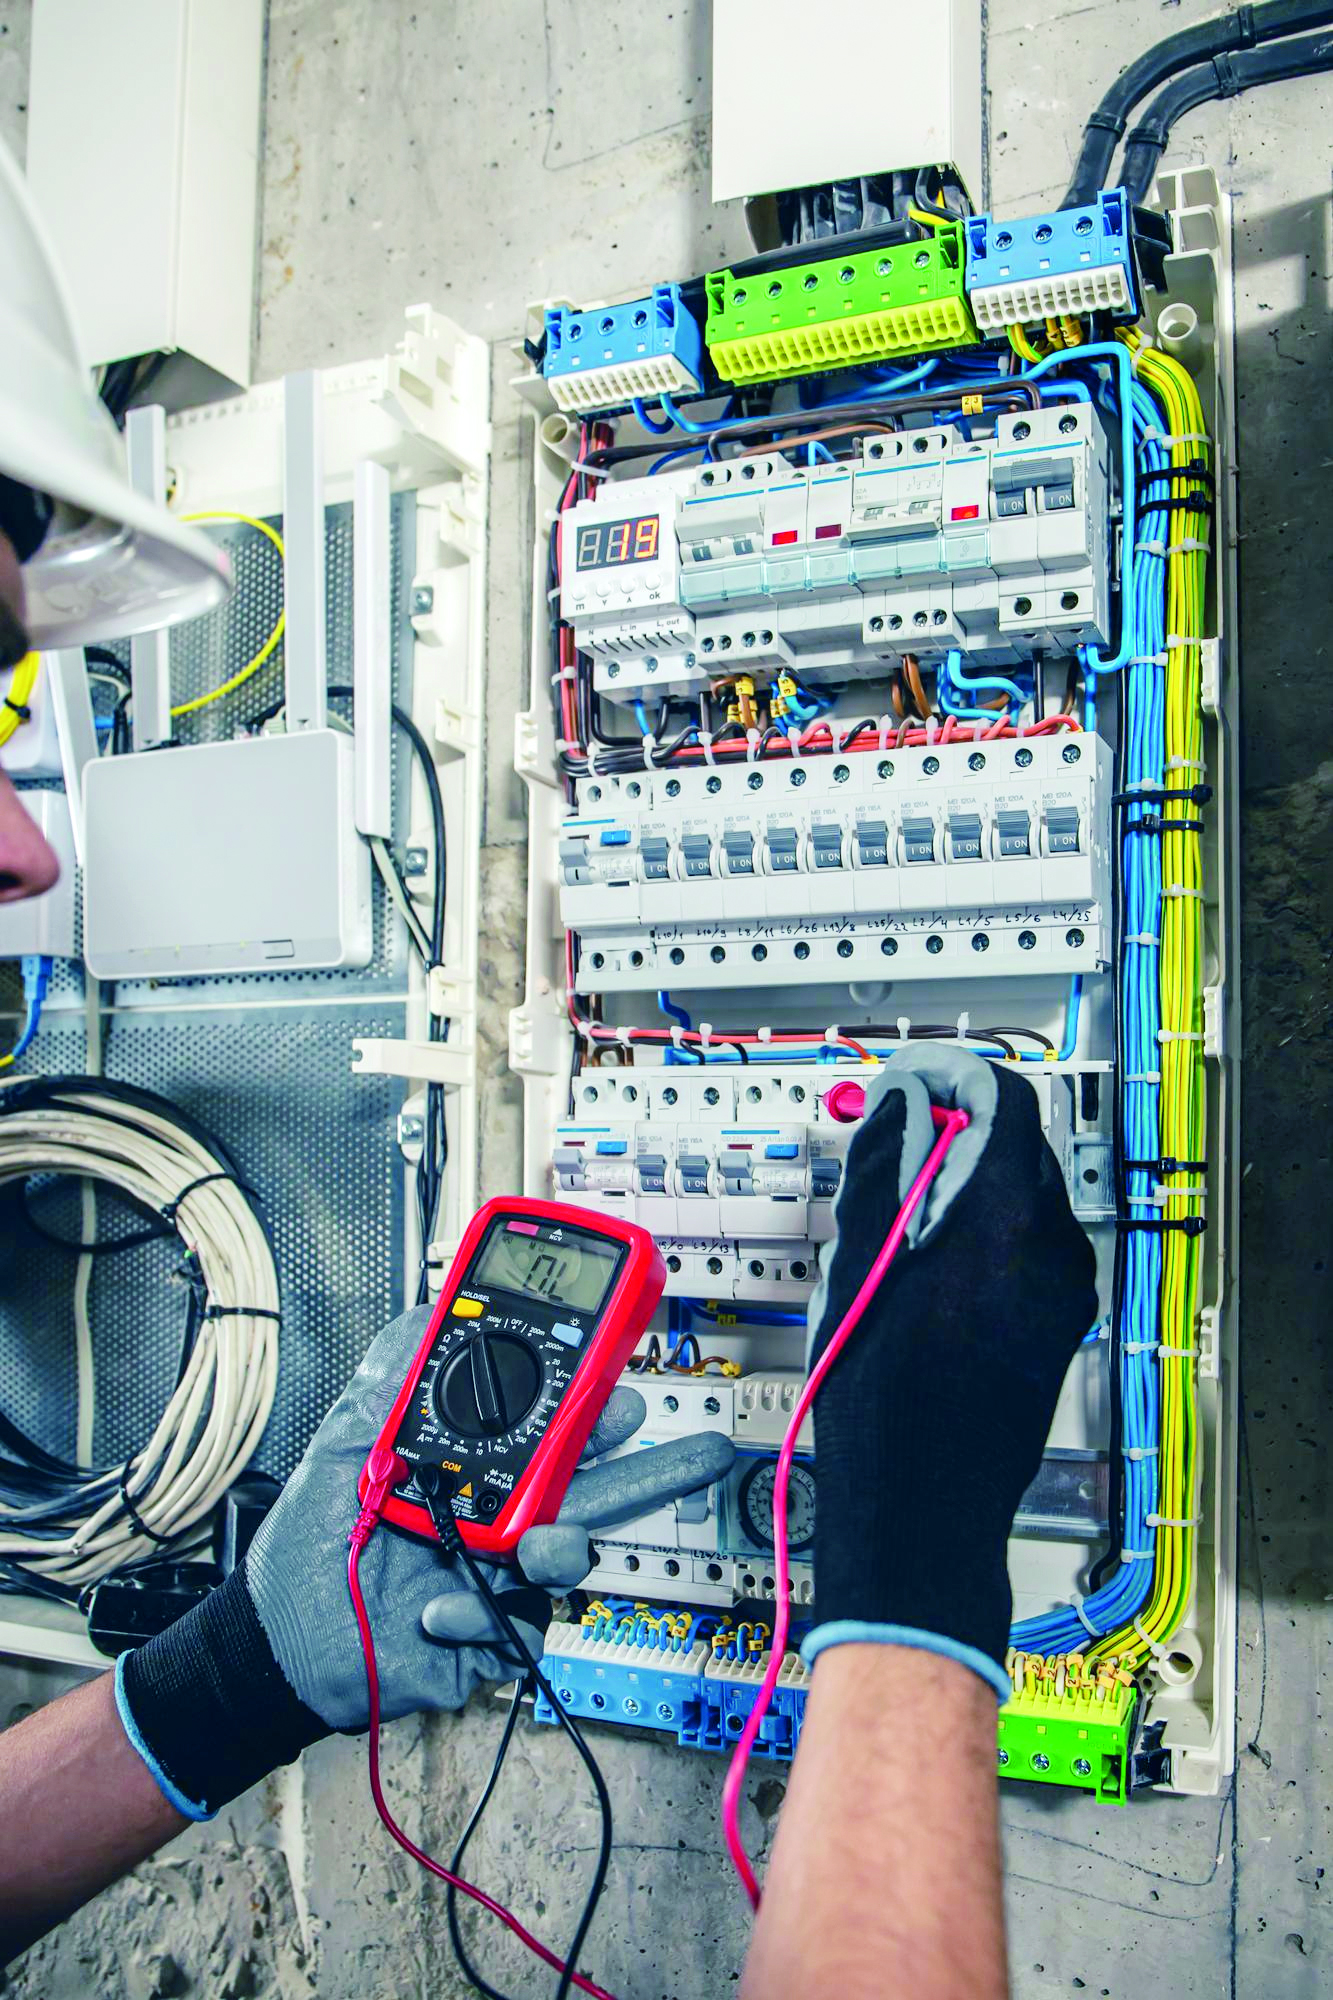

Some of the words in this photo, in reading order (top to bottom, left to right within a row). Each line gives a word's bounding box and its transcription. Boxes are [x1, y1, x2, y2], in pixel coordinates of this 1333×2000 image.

[1059, 494, 1072, 506] ON
[1011, 500, 1024, 512] ON
[649, 591, 661, 601] ok
[1015, 839, 1027, 848] ON
[1063, 836, 1076, 845] ON
[920, 846, 932, 854] ON
[966, 843, 979, 852] ON
[828, 853, 840, 861] ON
[874, 850, 886, 858] ON
[740, 859, 751, 867] ON
[461, 1290, 491, 1303] HOLD/SEL
[511, 1318, 523, 1326] OFF
[544, 1341, 564, 1352] 2000m
[552, 1358, 561, 1366] 20
[551, 1380, 564, 1388] 200
[438, 1437, 451, 1446] 20m
[515, 1435, 527, 1444] 200
[453, 1444, 469, 1454] 200m
[493, 1444, 508, 1454] NCV
[442, 1460, 462, 1473] COM
